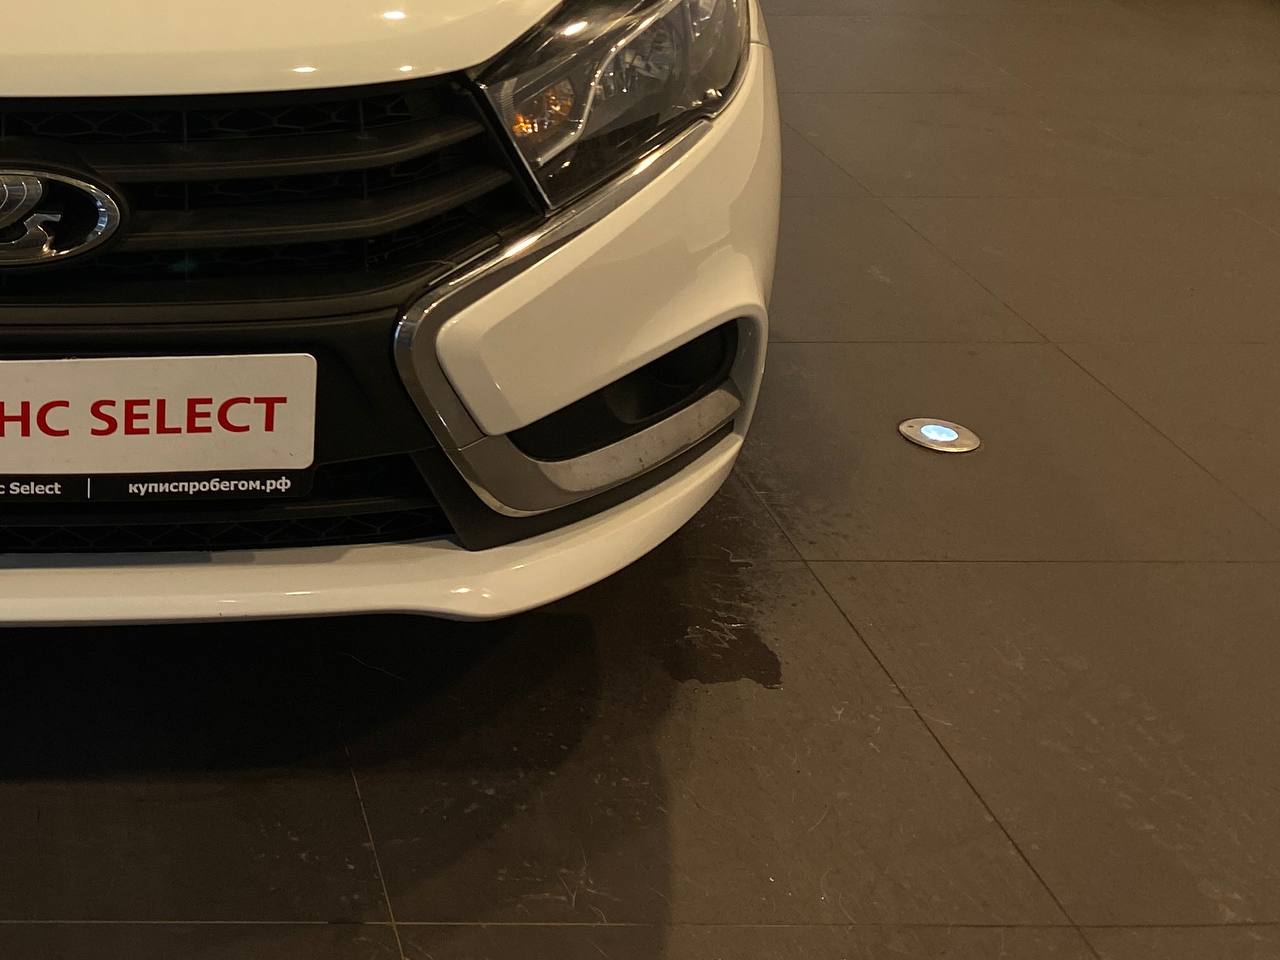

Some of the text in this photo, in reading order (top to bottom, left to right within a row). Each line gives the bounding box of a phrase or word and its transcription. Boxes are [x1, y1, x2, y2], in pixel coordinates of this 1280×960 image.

[90, 397, 287, 436] SELECT
[9, 481, 62, 494] Select
[128, 477, 291, 496] куписпробегом.рф
